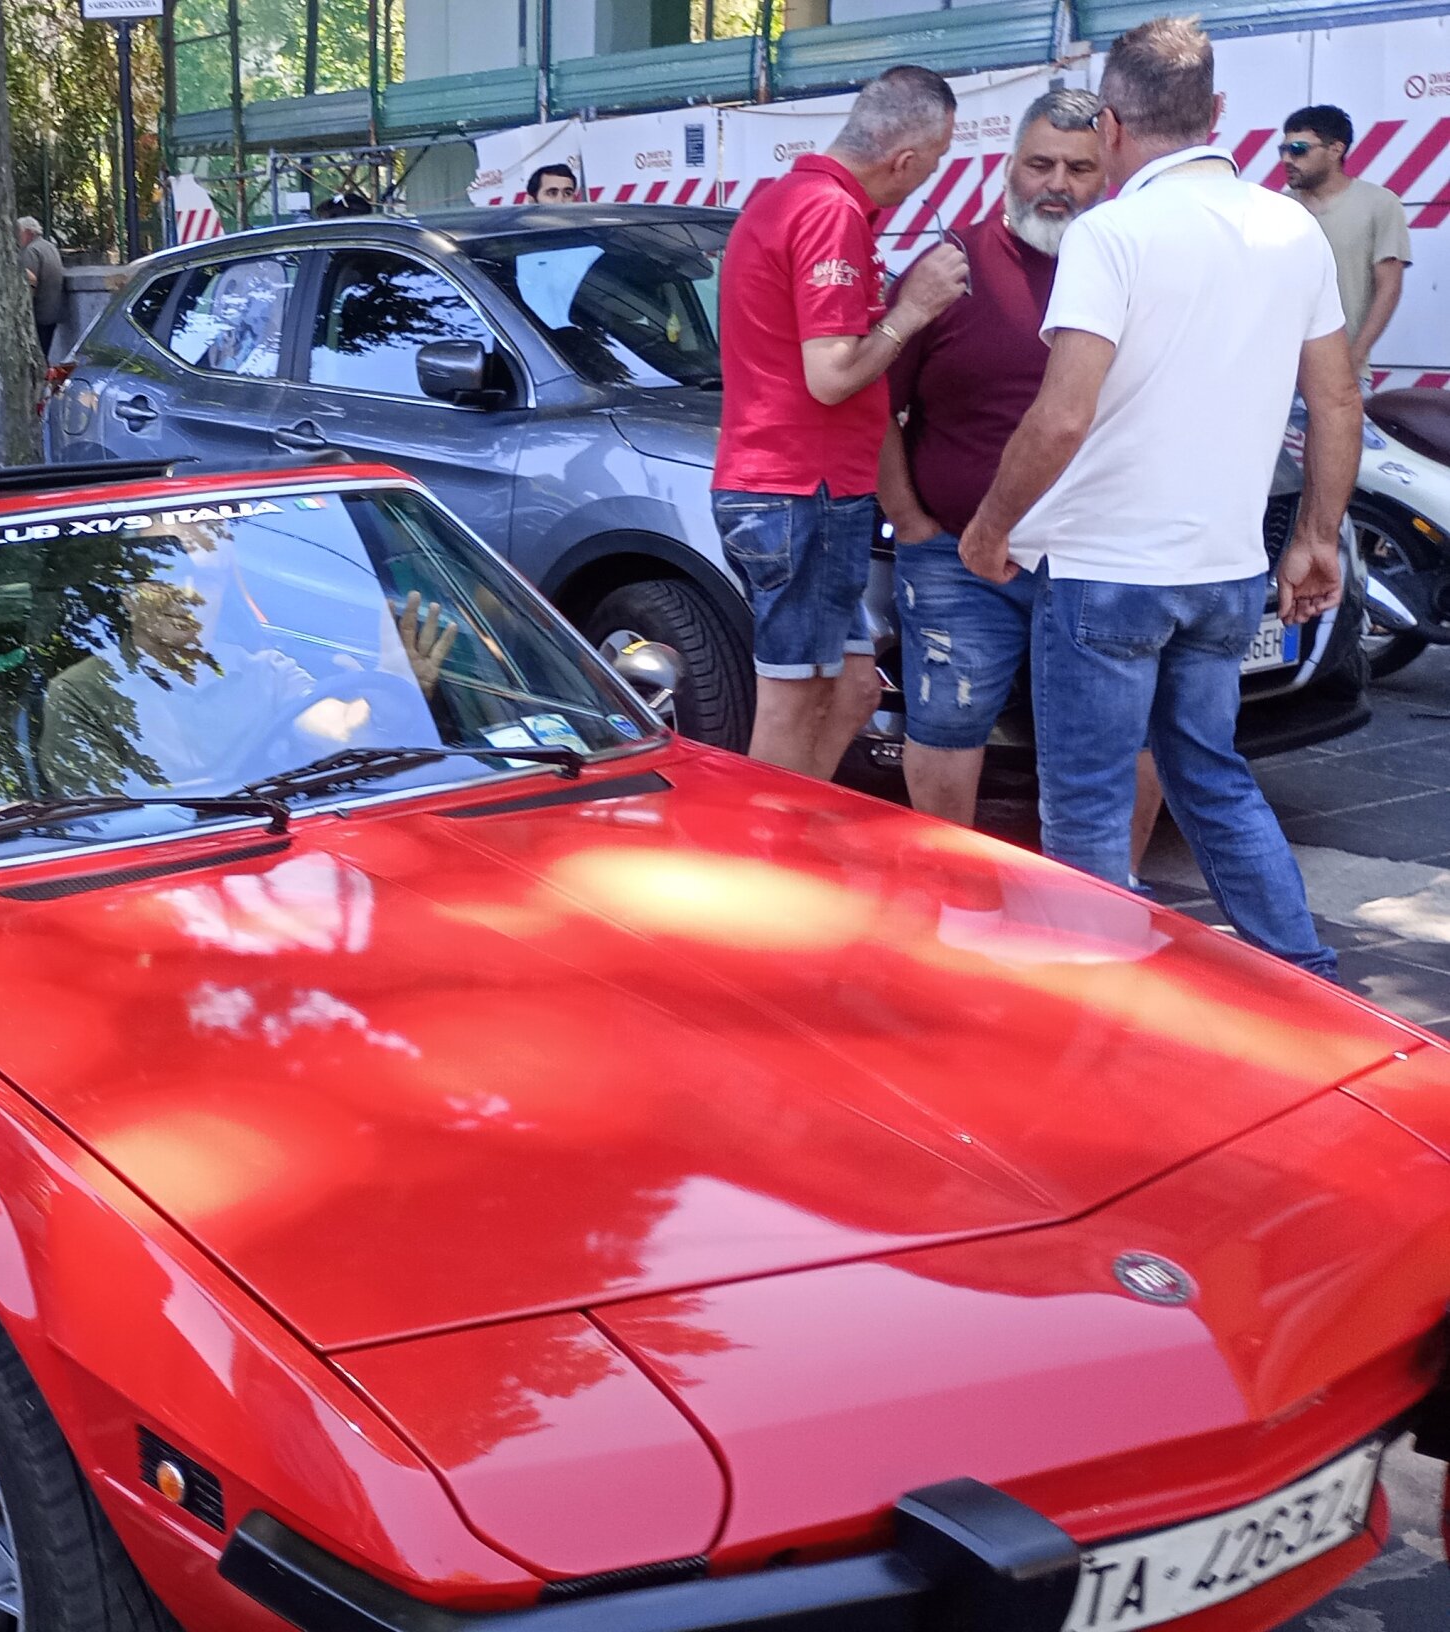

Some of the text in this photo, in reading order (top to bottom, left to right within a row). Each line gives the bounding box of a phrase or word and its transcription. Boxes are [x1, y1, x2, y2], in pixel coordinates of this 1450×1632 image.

[68, 514, 153, 536] X1/9
[161, 500, 285, 527] ITALIA
[1243, 627, 1285, 661] 6EH
